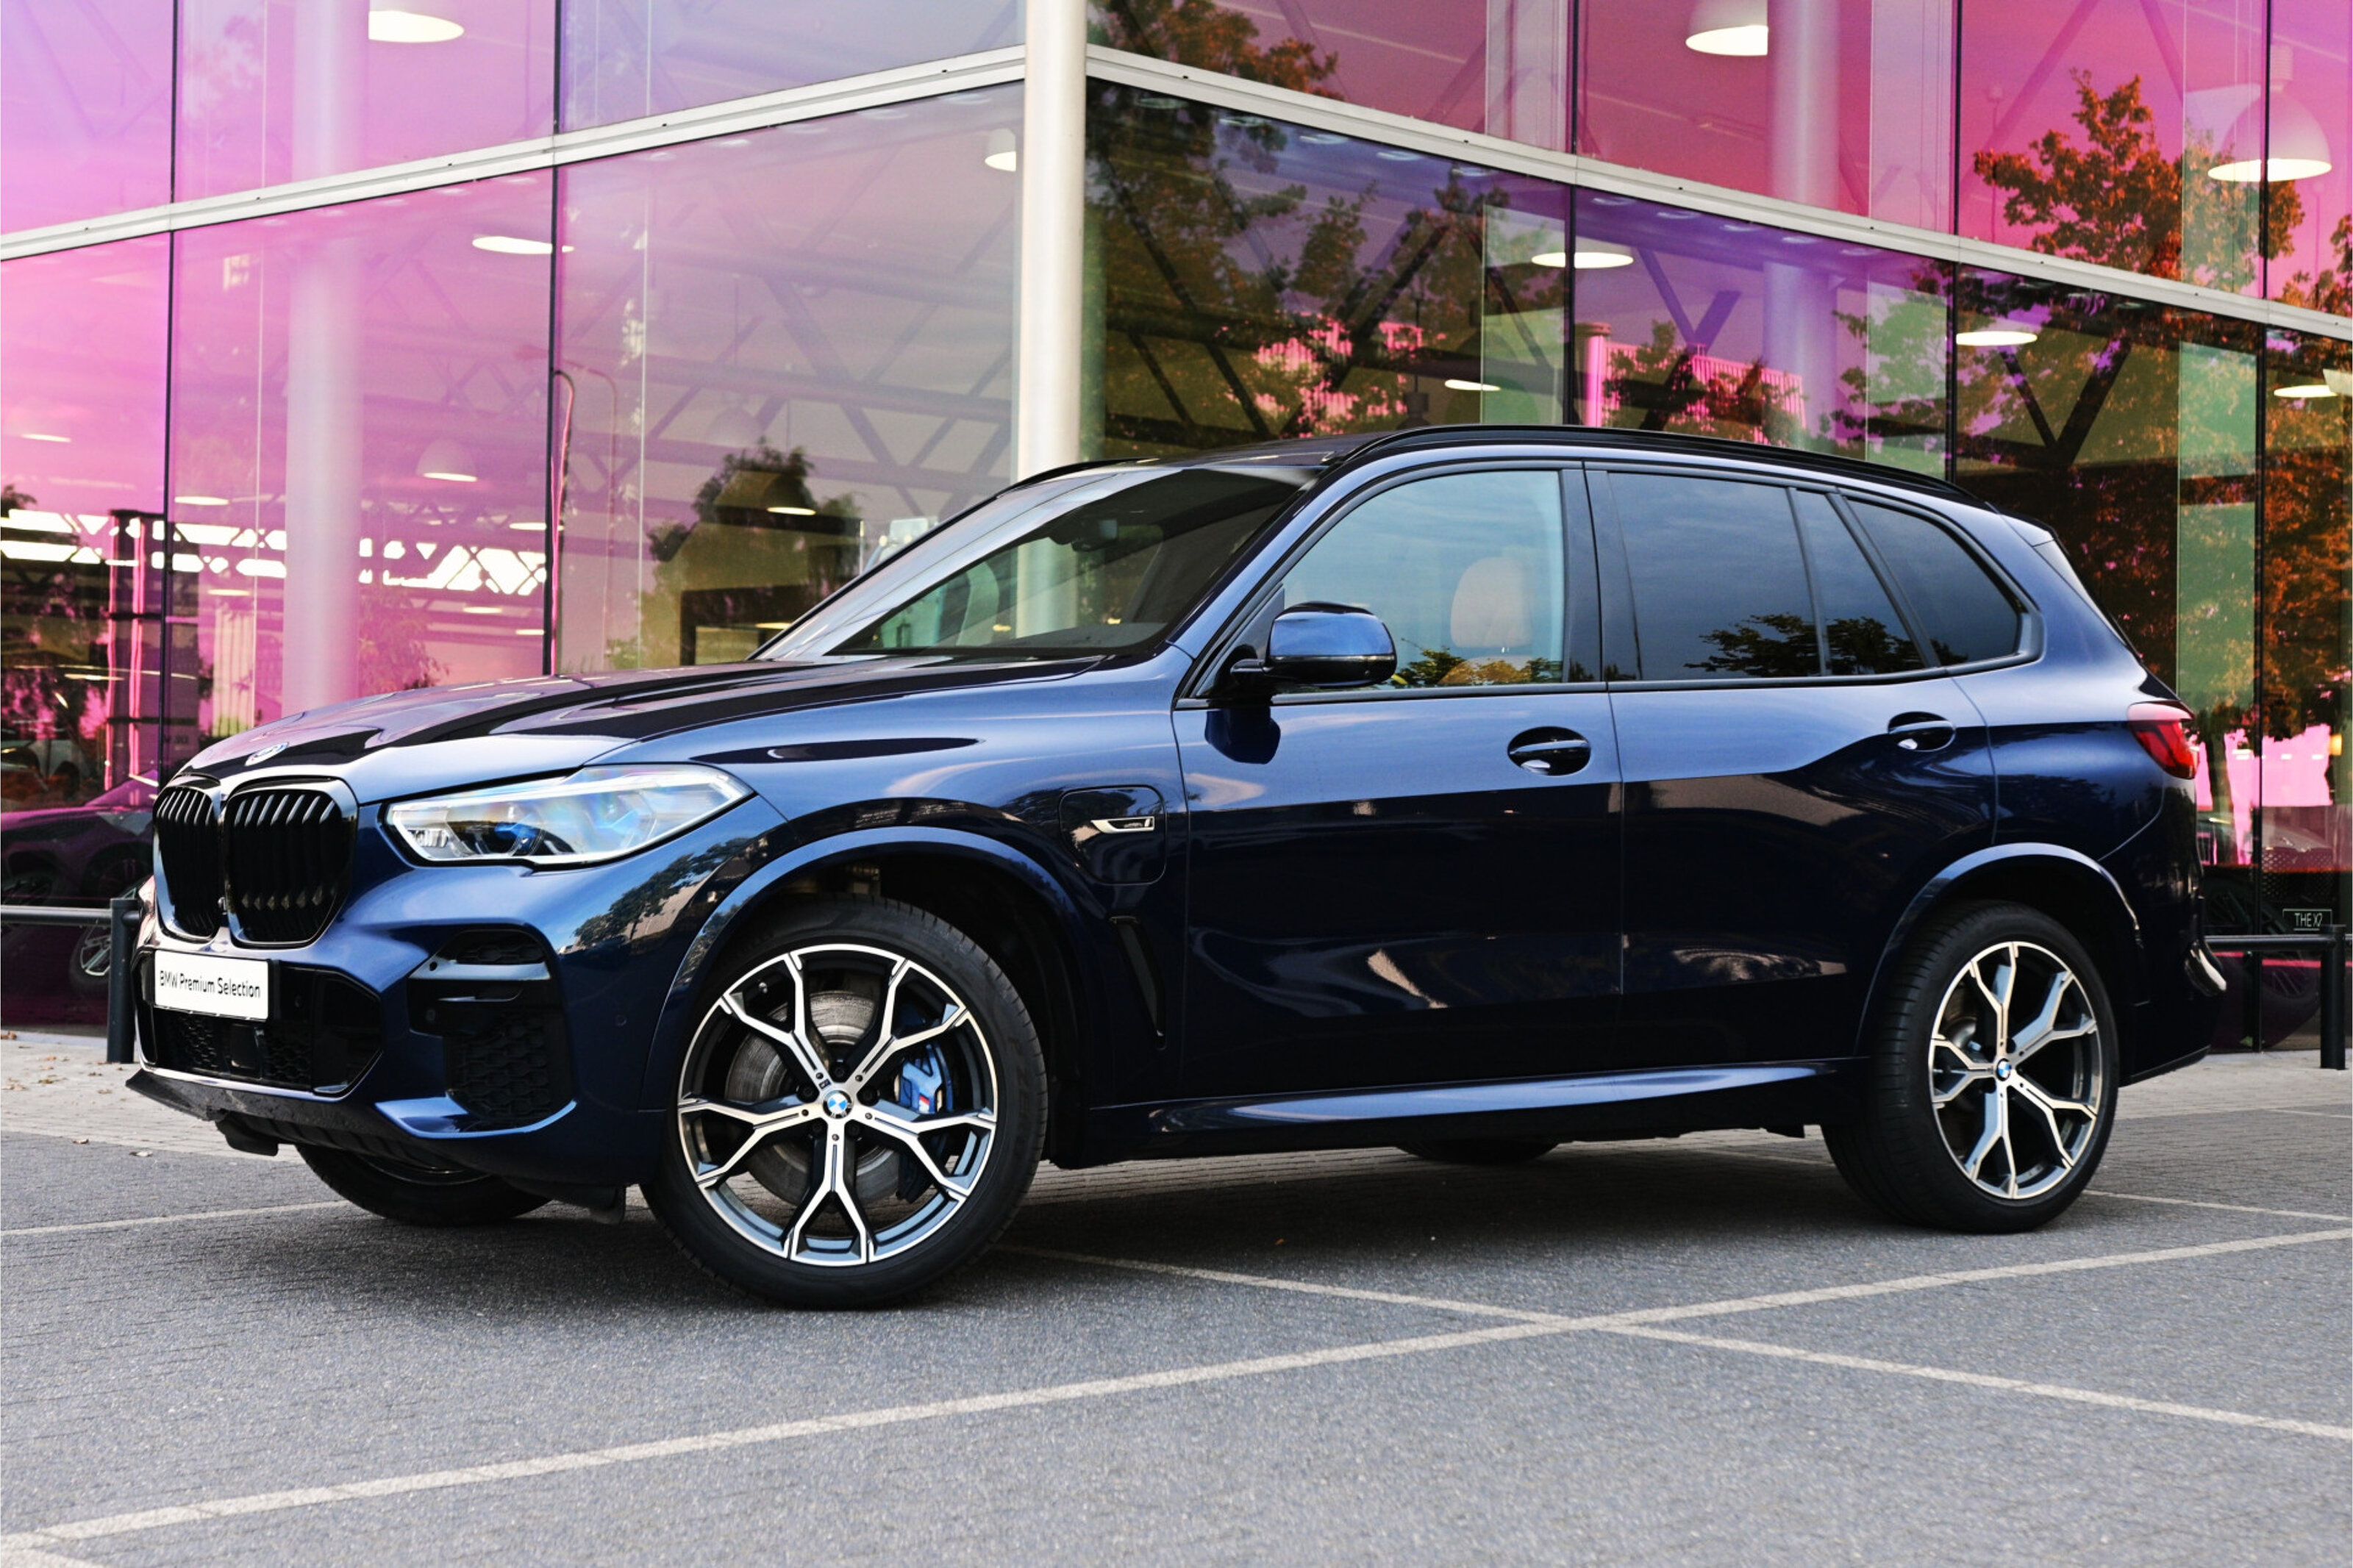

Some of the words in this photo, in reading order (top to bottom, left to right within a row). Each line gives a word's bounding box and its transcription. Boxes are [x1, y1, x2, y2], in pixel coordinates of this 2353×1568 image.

[2294, 912, 2312, 927] THE
[160, 970, 178, 989] BMW
[179, 973, 215, 993] Premium
[218, 977, 261, 998] Selection
